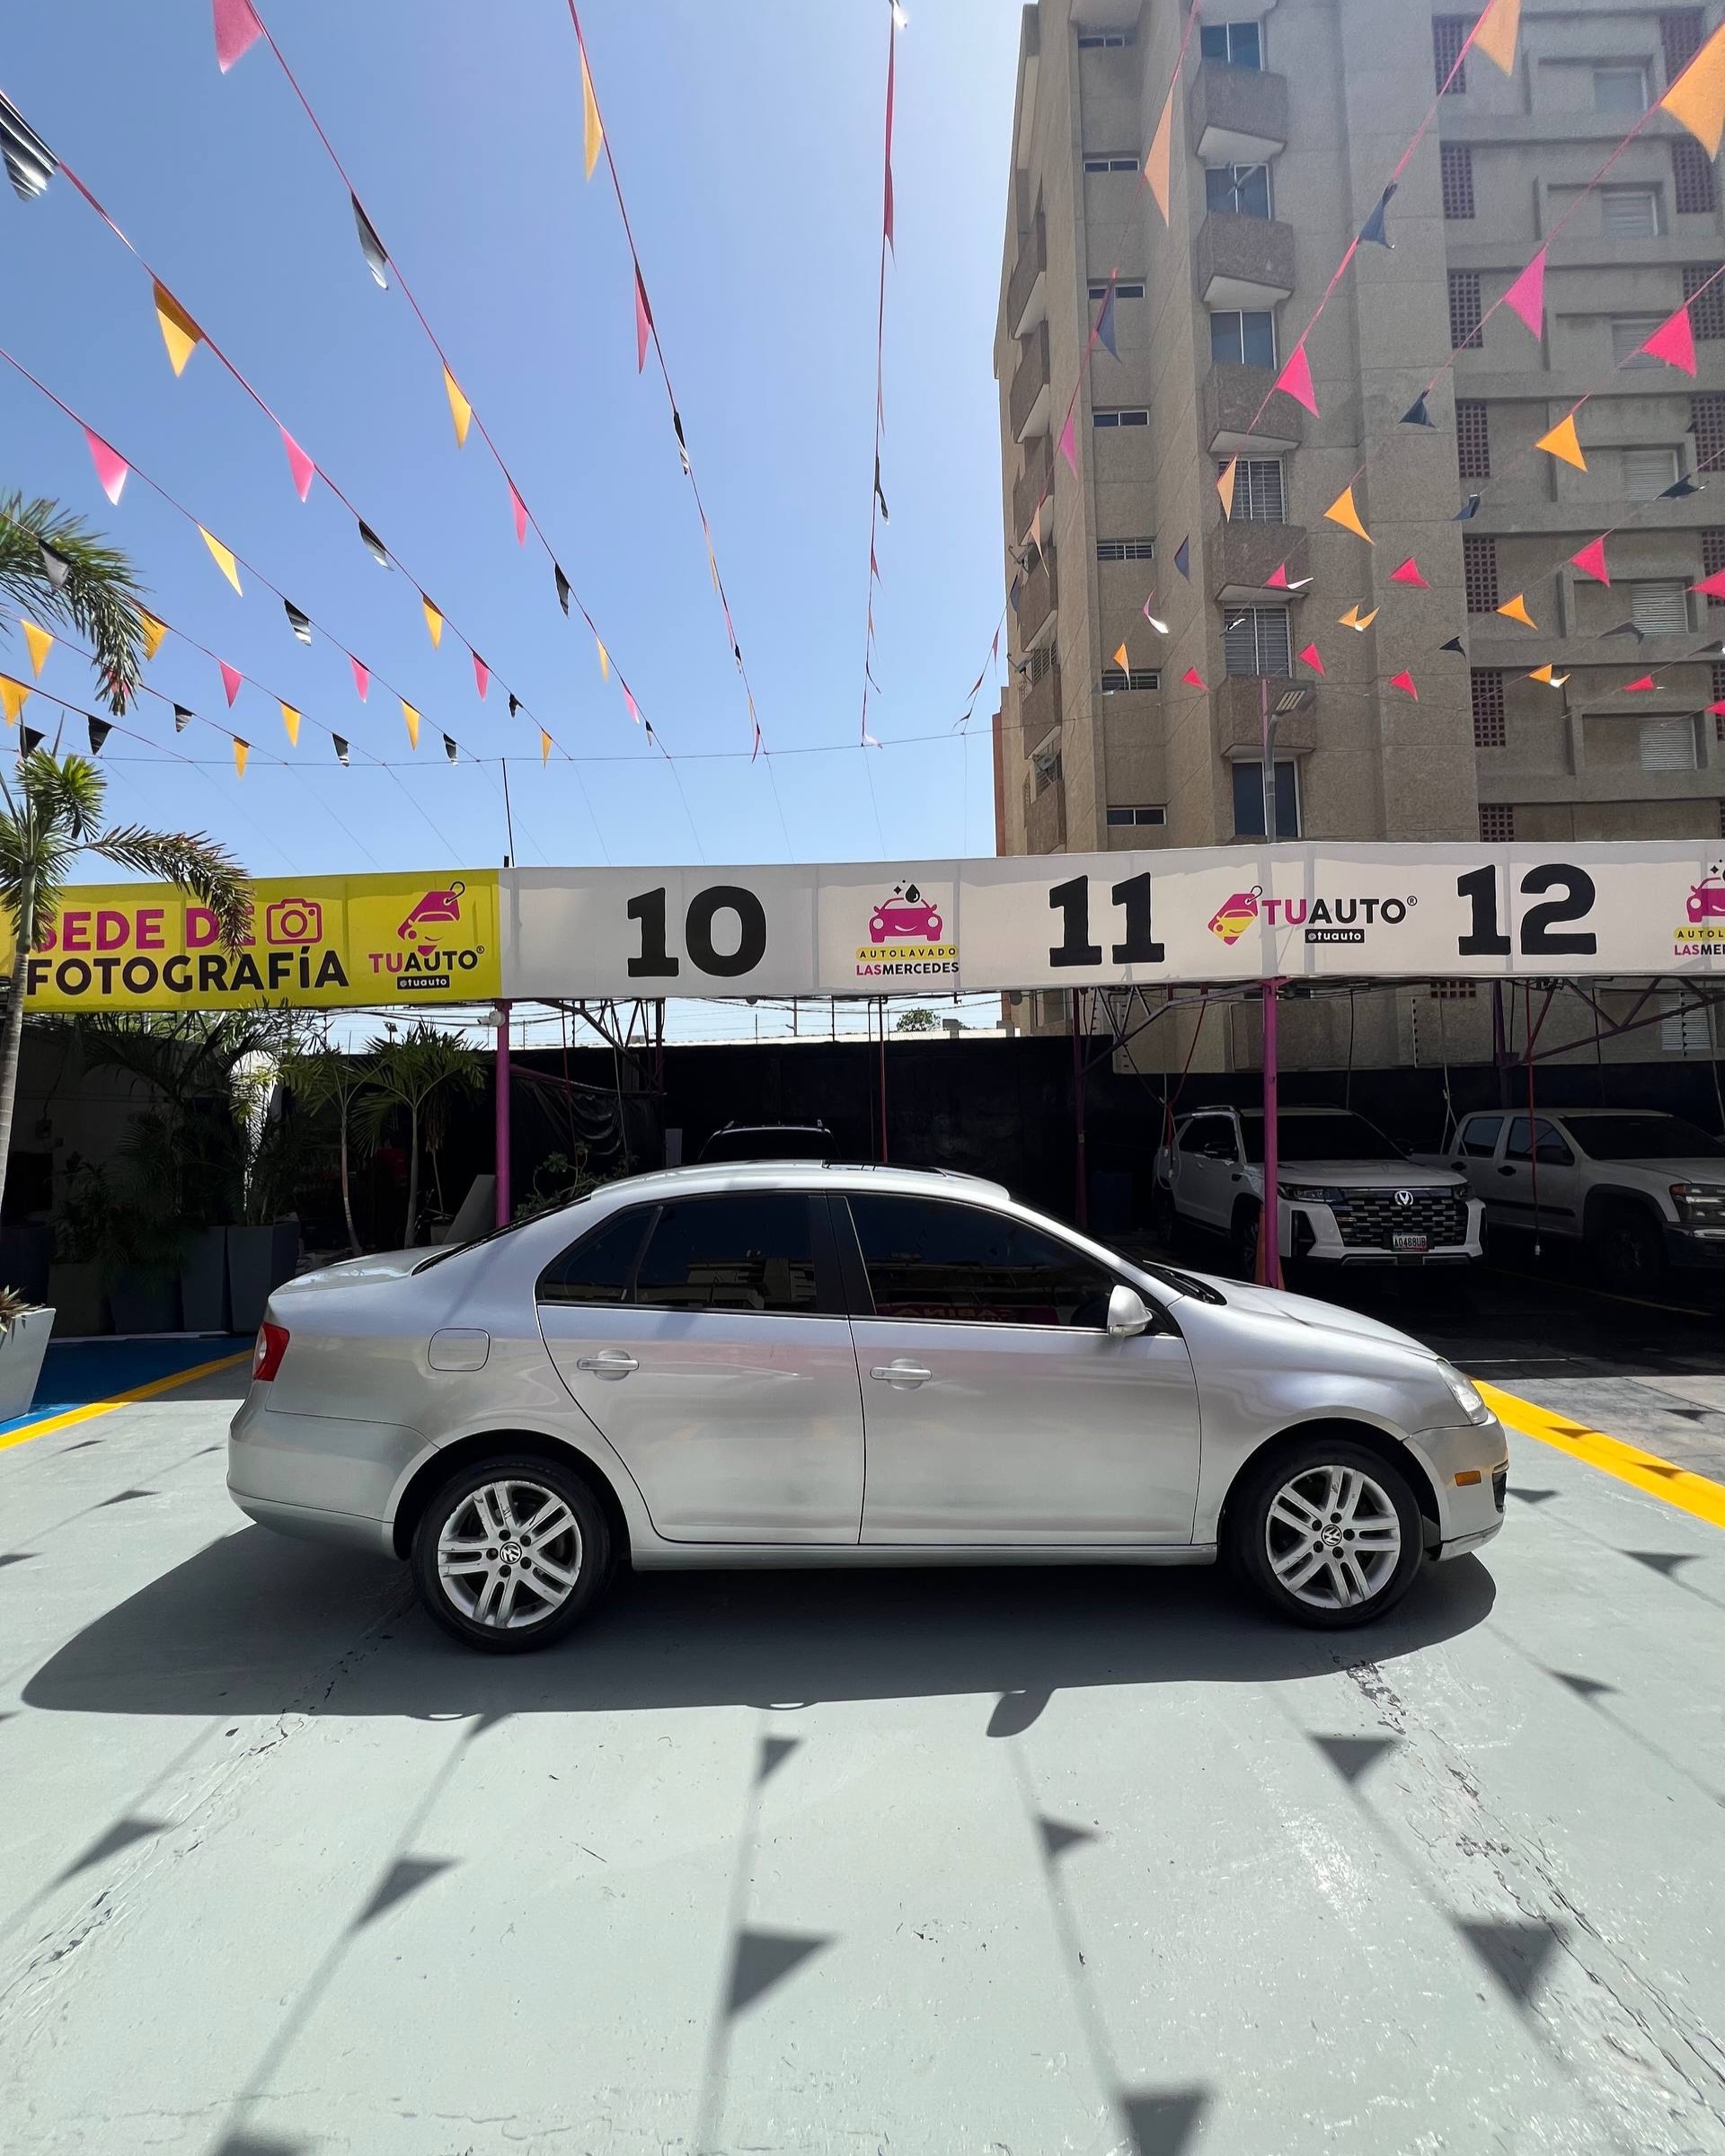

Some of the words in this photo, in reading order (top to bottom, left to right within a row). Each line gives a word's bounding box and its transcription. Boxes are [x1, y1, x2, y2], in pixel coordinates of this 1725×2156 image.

[1049, 872, 1165, 967] 11
[1457, 864, 1597, 956] 12
[628, 886, 766, 977] 10
[1308, 932, 1362, 941] @tuauto
[860, 948, 956, 959] AUTOLAVADO
[1674, 944, 1725, 956] LASME
[27, 946, 349, 995] FOTOGRAFÍA
[400, 977, 447, 987] @tuauto
